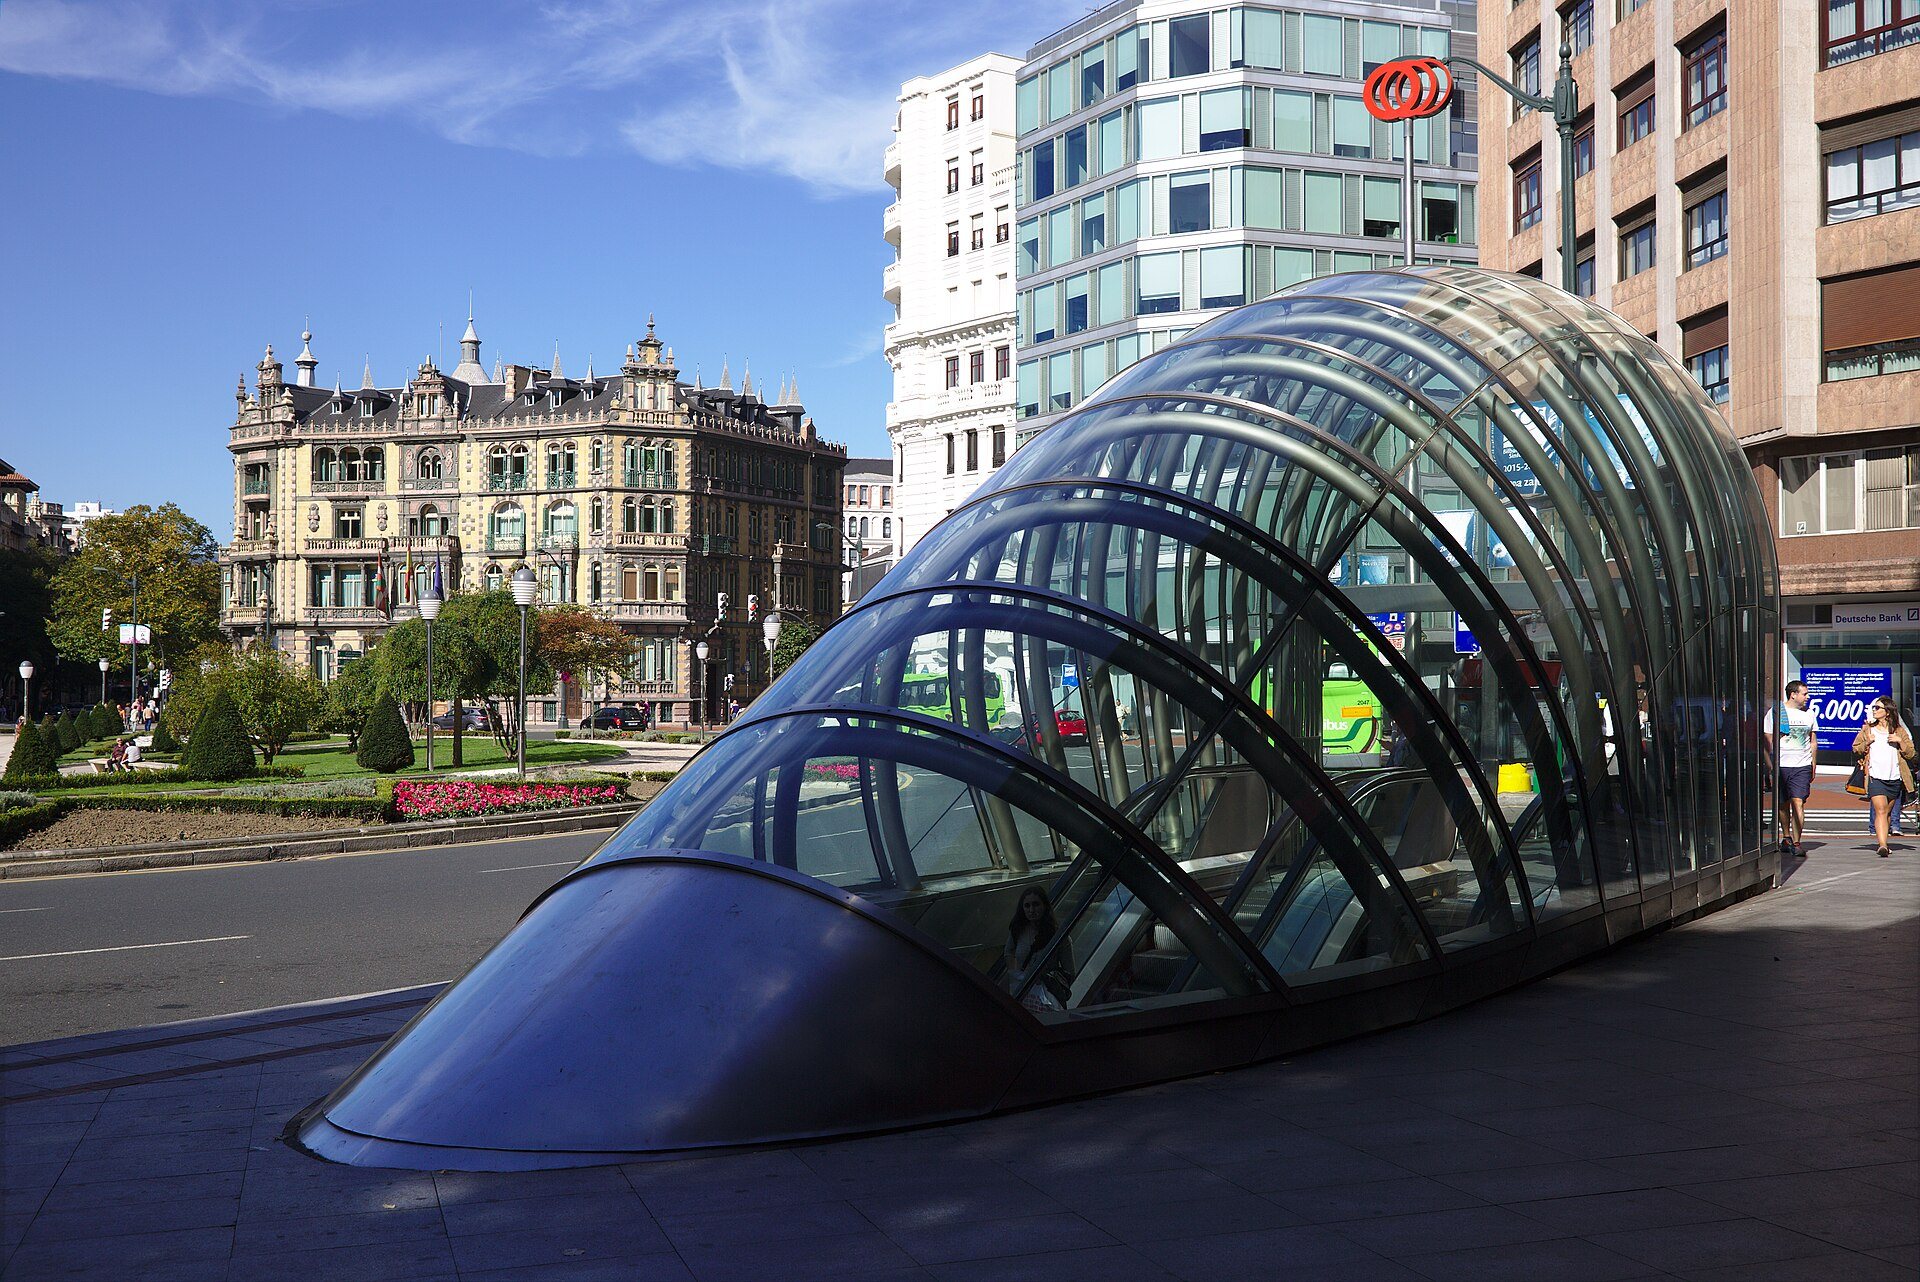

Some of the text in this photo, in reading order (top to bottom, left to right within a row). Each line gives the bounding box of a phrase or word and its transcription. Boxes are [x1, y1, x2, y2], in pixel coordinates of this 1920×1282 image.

[1503, 463, 1531, 472] 2015-2
[1835, 613, 1902, 624] Deutsche Bank
[1323, 718, 1348, 731] ibus
